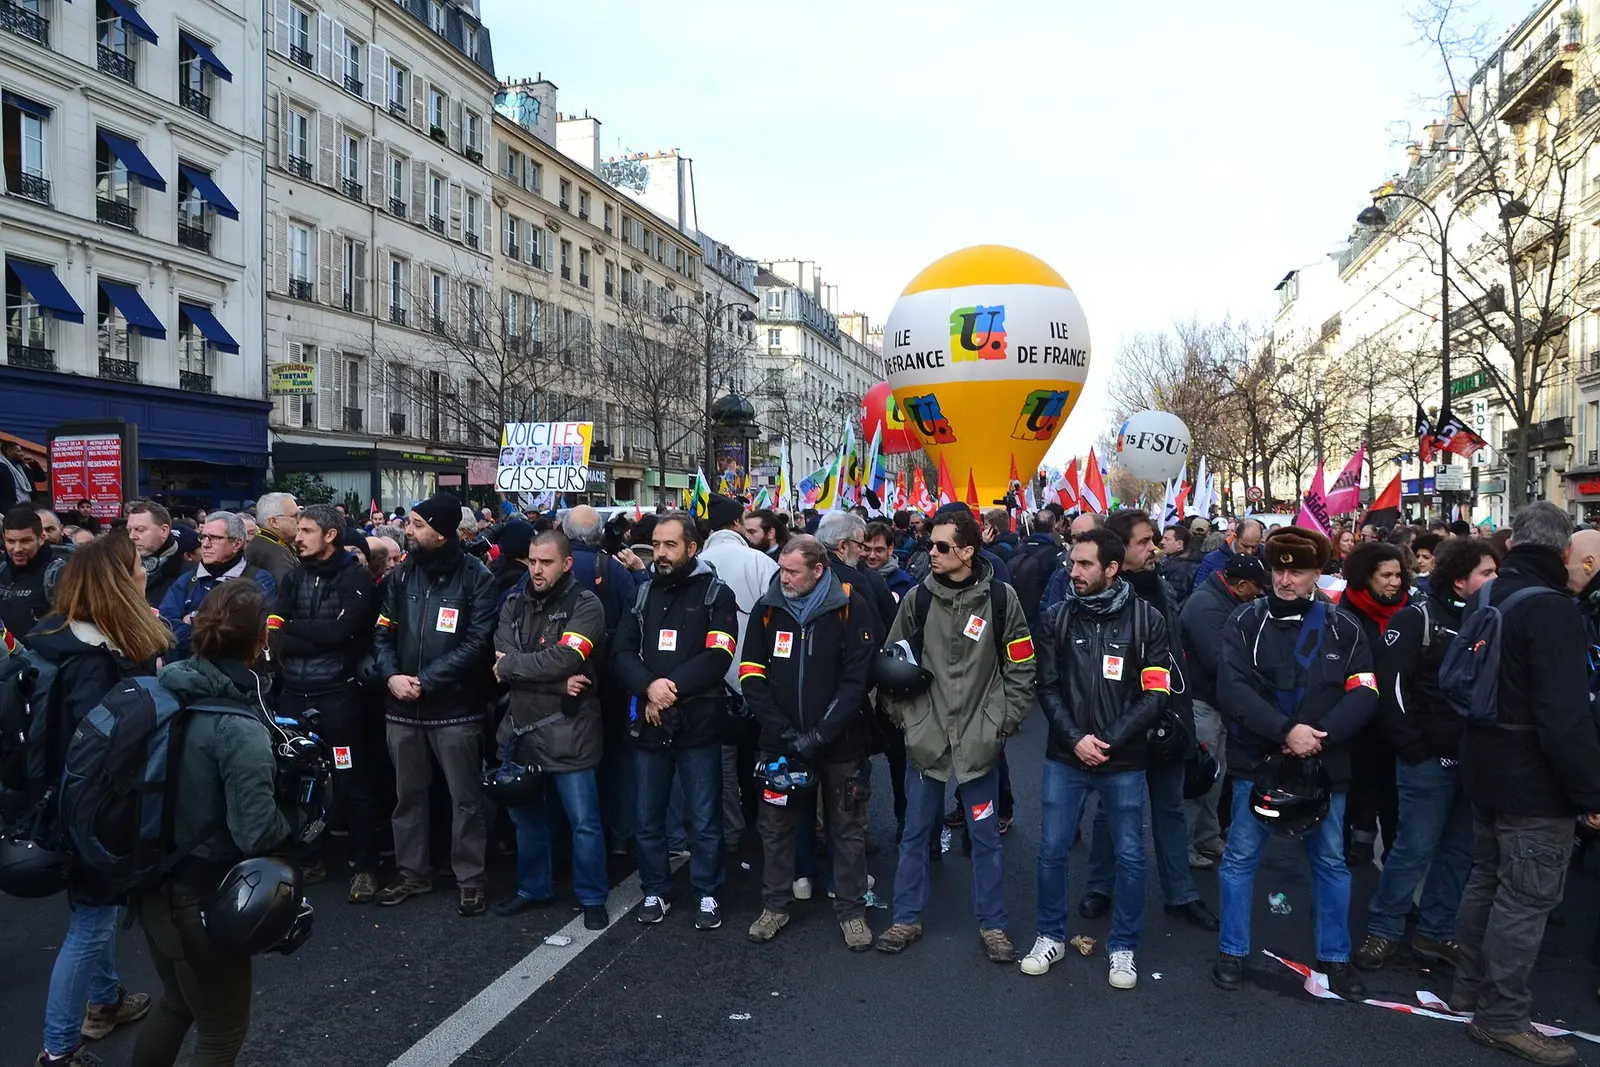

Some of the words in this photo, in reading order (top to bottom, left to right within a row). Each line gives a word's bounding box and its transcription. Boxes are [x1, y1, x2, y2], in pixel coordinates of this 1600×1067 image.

[895, 329, 911, 348] ILE
[1050, 321, 1068, 340] ILE
[885, 356, 893, 376] DE
[893, 350, 945, 371] FRANCE
[1018, 346, 1038, 364] DE
[1044, 346, 1086, 367] FRANCE
[272, 363, 314, 375] RESTAURANT
[504, 422, 553, 446] VOICI
[552, 422, 584, 446] LES
[1136, 431, 1181, 455] FSU
[1476, 402, 1485, 462] HOTL
[498, 466, 588, 491] CASSEURS
[587, 469, 606, 483] MACIE
